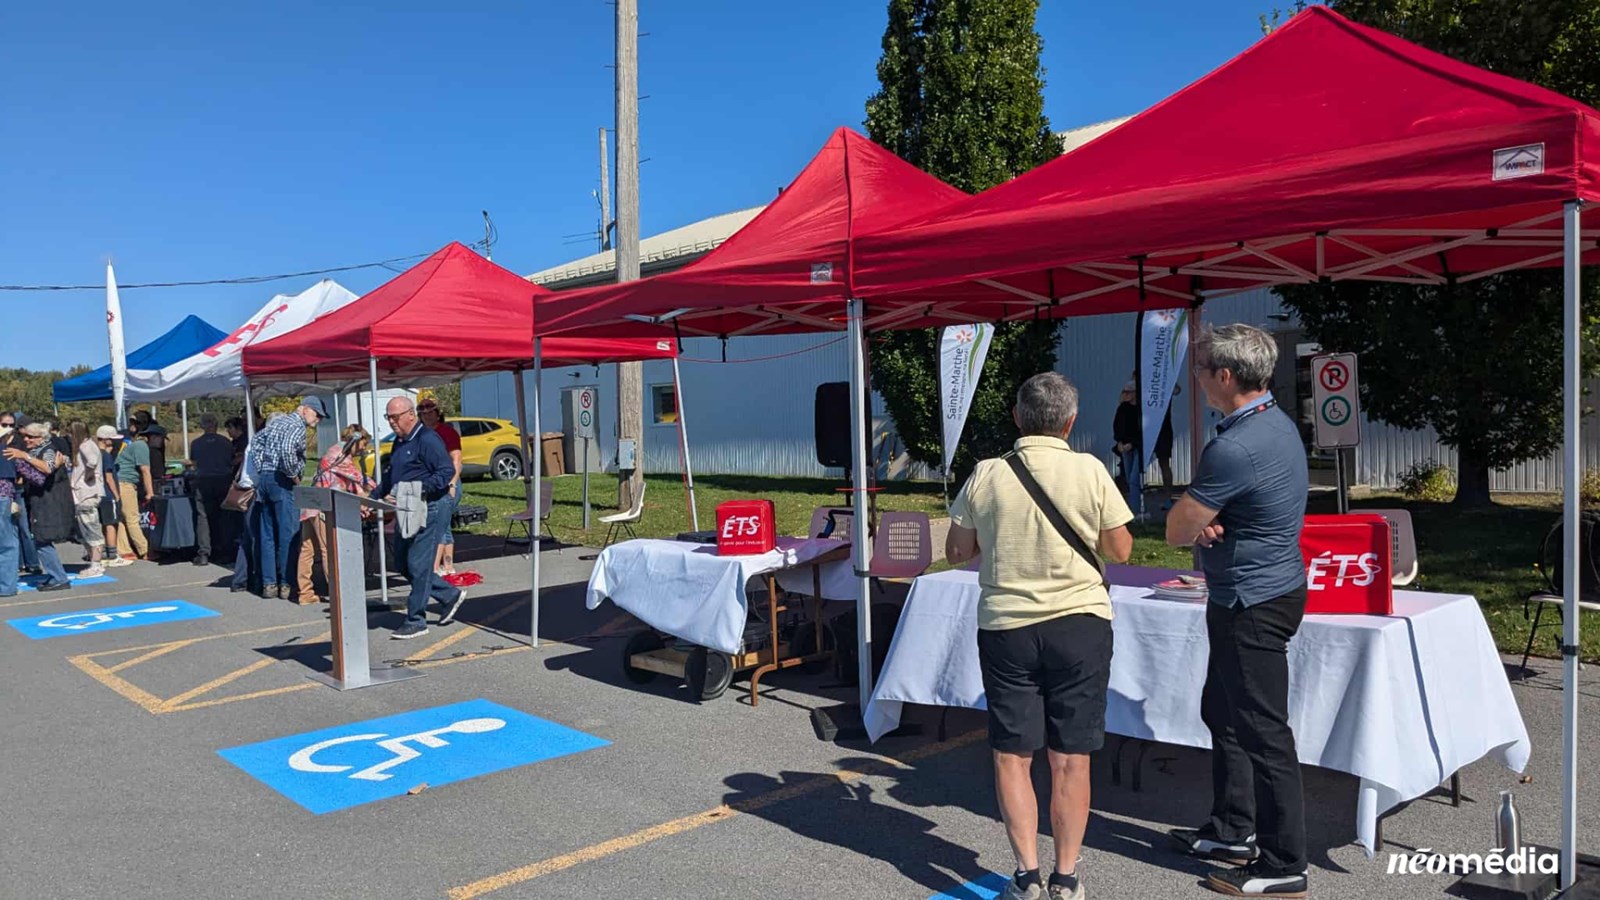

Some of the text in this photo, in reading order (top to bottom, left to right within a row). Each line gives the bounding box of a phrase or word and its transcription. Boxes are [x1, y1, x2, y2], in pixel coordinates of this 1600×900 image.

[947, 348, 963, 420] Sainte-Marthe
[1147, 326, 1167, 407] Sainte-Marthe
[722, 515, 760, 539] ÉTS
[1307, 550, 1378, 590] ÉTS
